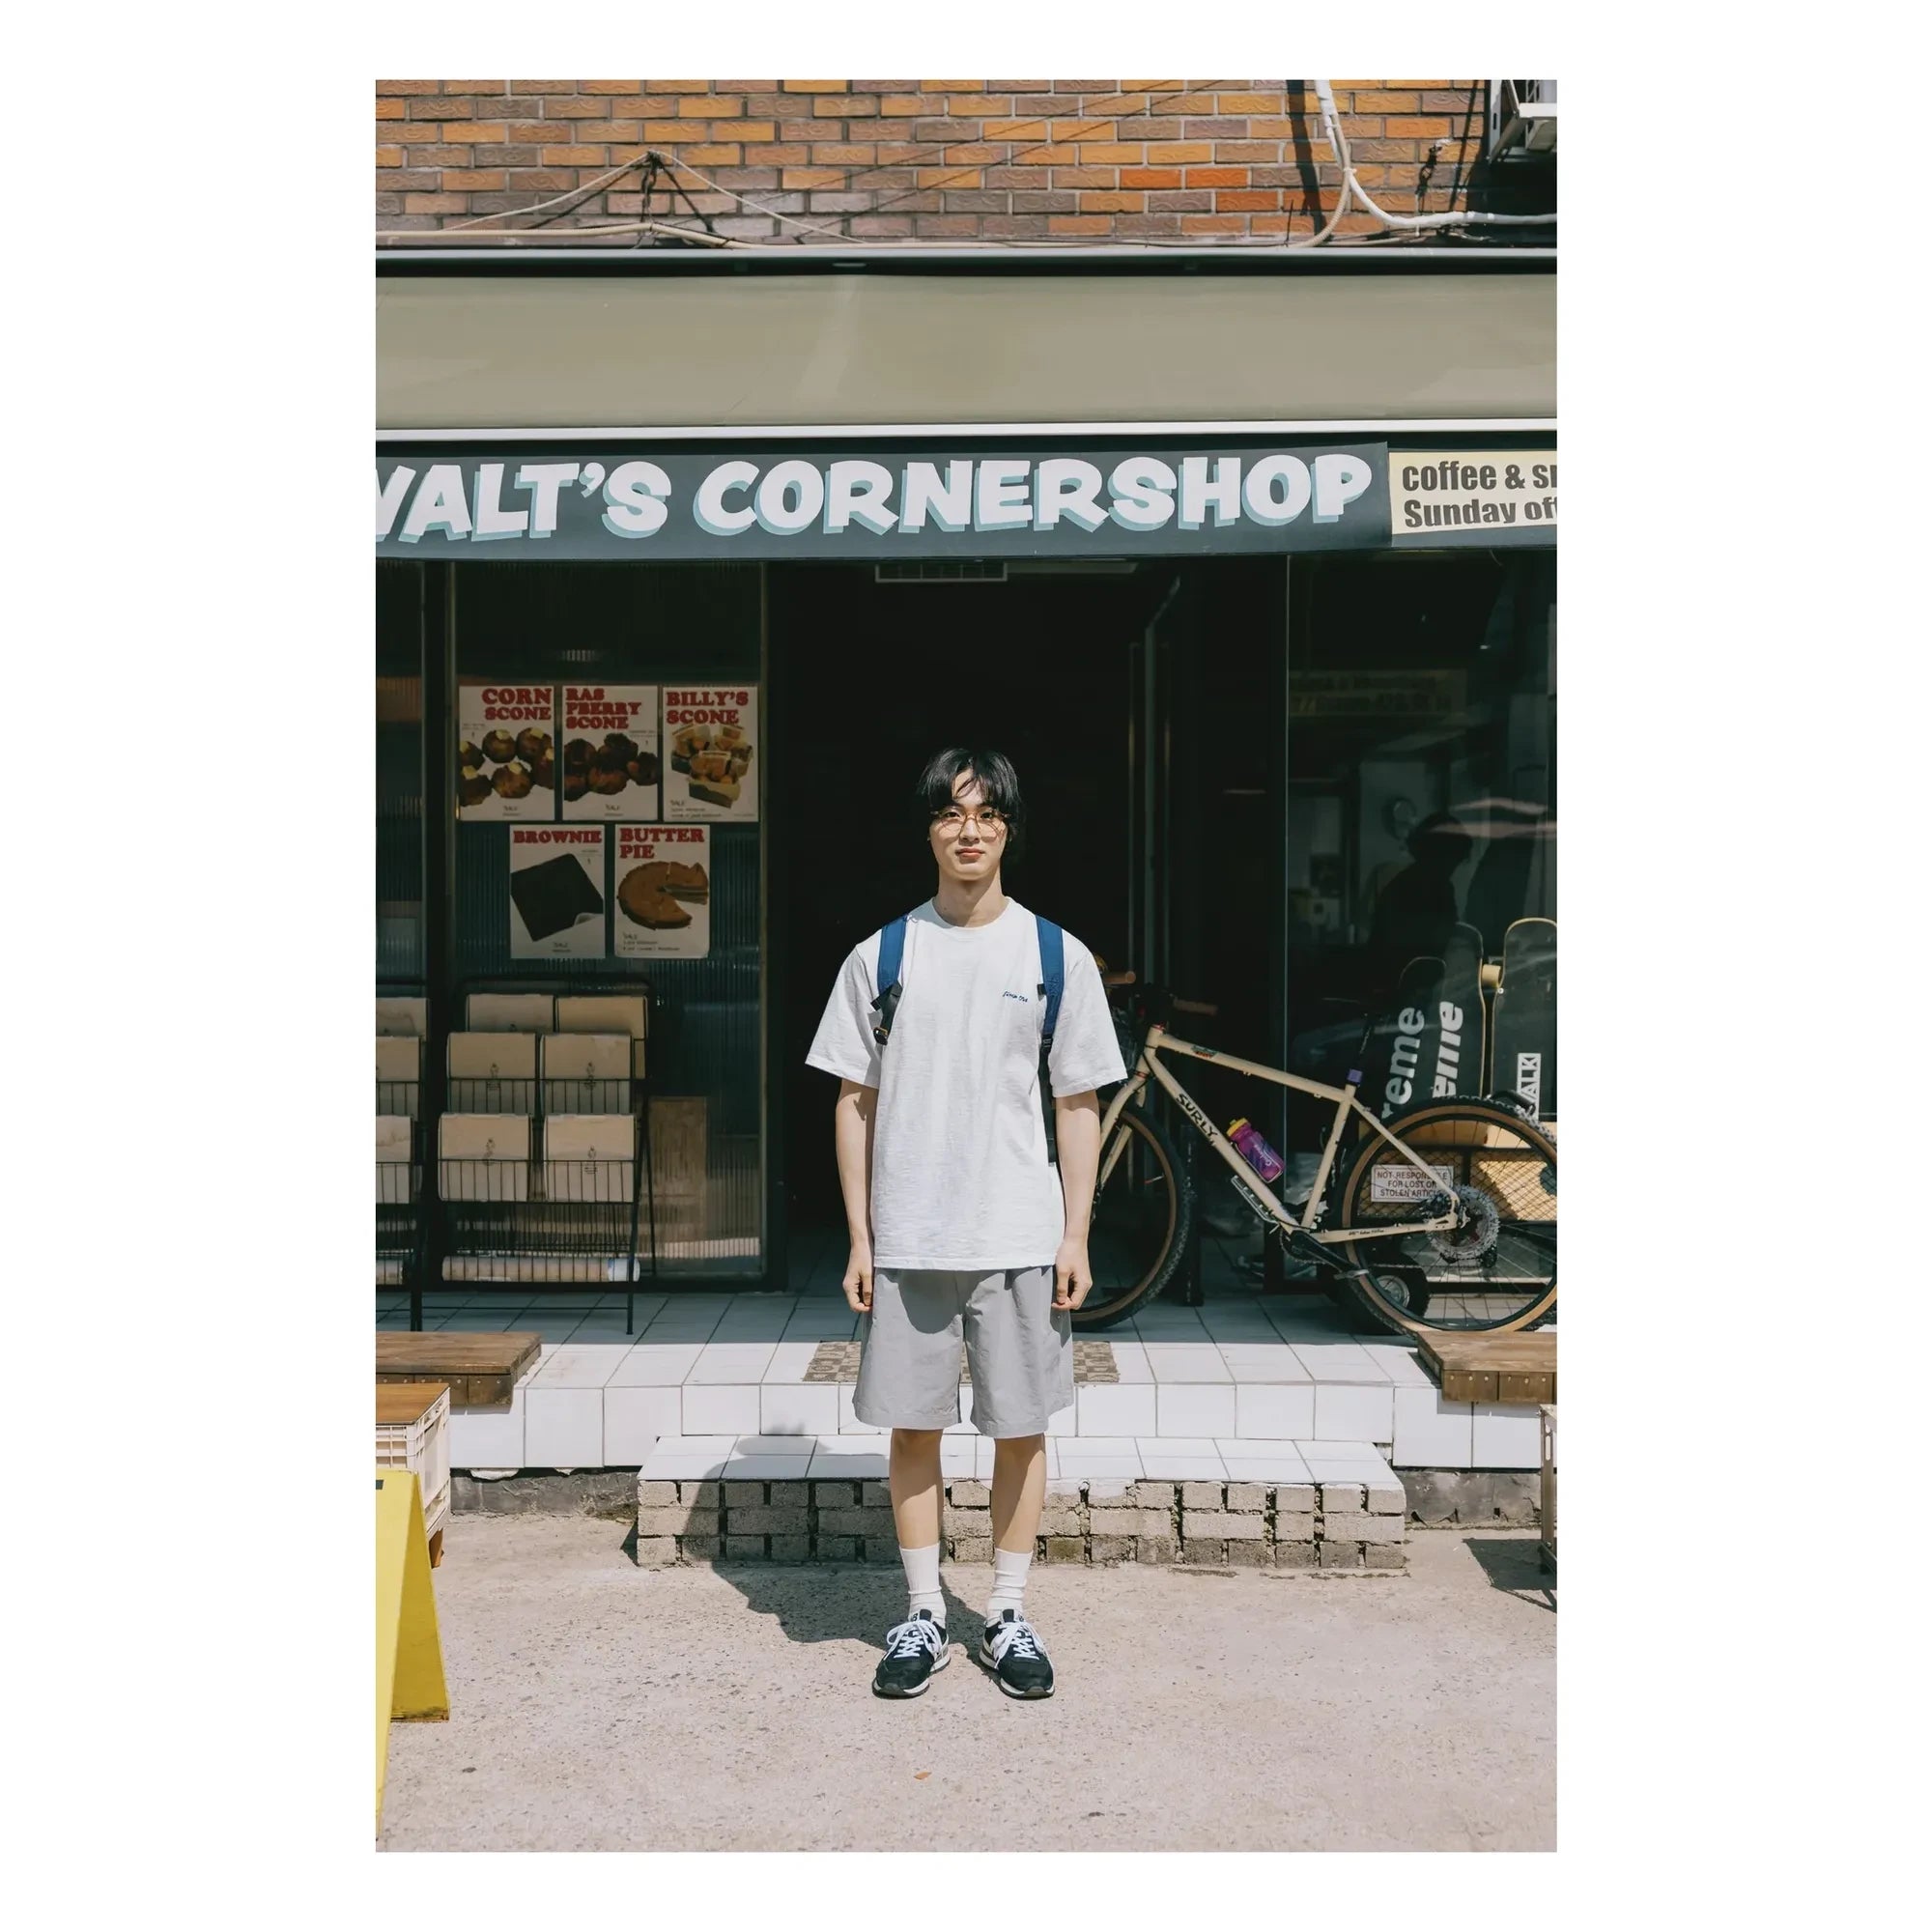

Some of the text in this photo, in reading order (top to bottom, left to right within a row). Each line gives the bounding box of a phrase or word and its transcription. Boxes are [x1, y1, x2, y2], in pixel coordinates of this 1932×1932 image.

[1402, 461, 1496, 492] coffee
[1504, 464, 1525, 489] &
[693, 454, 1373, 537] CORNERSHOP
[1404, 498, 1517, 528] Sunday
[481, 688, 552, 705] CORN
[566, 688, 605, 701] RAS
[667, 691, 749, 706] BILLY'S
[485, 707, 551, 721] SCONE
[667, 709, 739, 724] SCONE
[566, 716, 630, 729] SCONE
[513, 830, 603, 843] BROWNIE
[619, 828, 705, 842] BUTTER
[619, 844, 655, 859] PIE
[1175, 1093, 1218, 1137] SURLY
[1377, 1171, 1392, 1179] NOT
[1380, 1188, 1409, 1197] STOLEN
